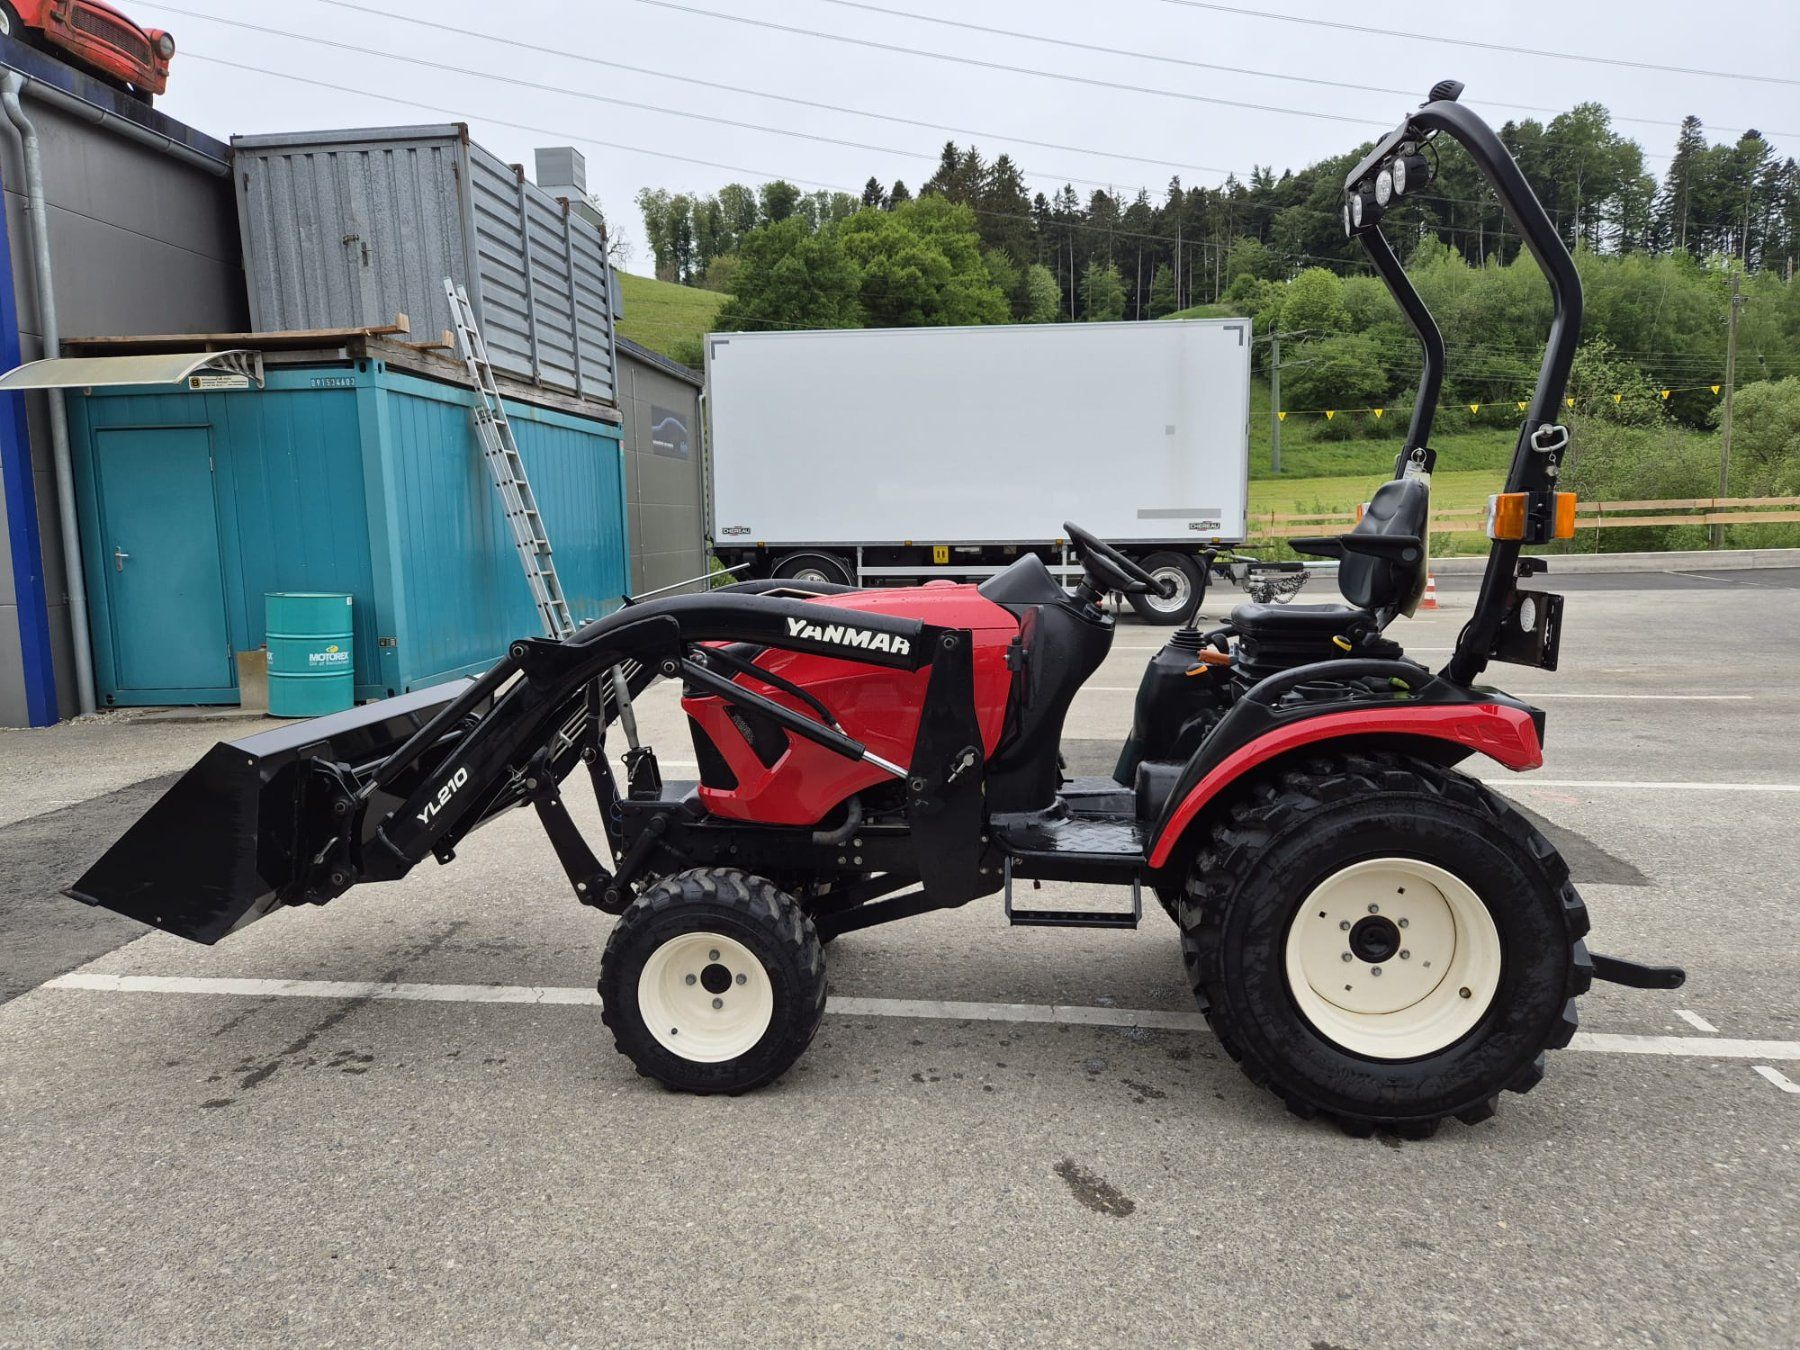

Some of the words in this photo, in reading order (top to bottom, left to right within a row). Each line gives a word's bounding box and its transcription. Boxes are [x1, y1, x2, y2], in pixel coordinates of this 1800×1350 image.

[787, 617, 911, 656] YANMAR
[309, 651, 349, 662] MOTOREX
[416, 767, 468, 825] YL210
